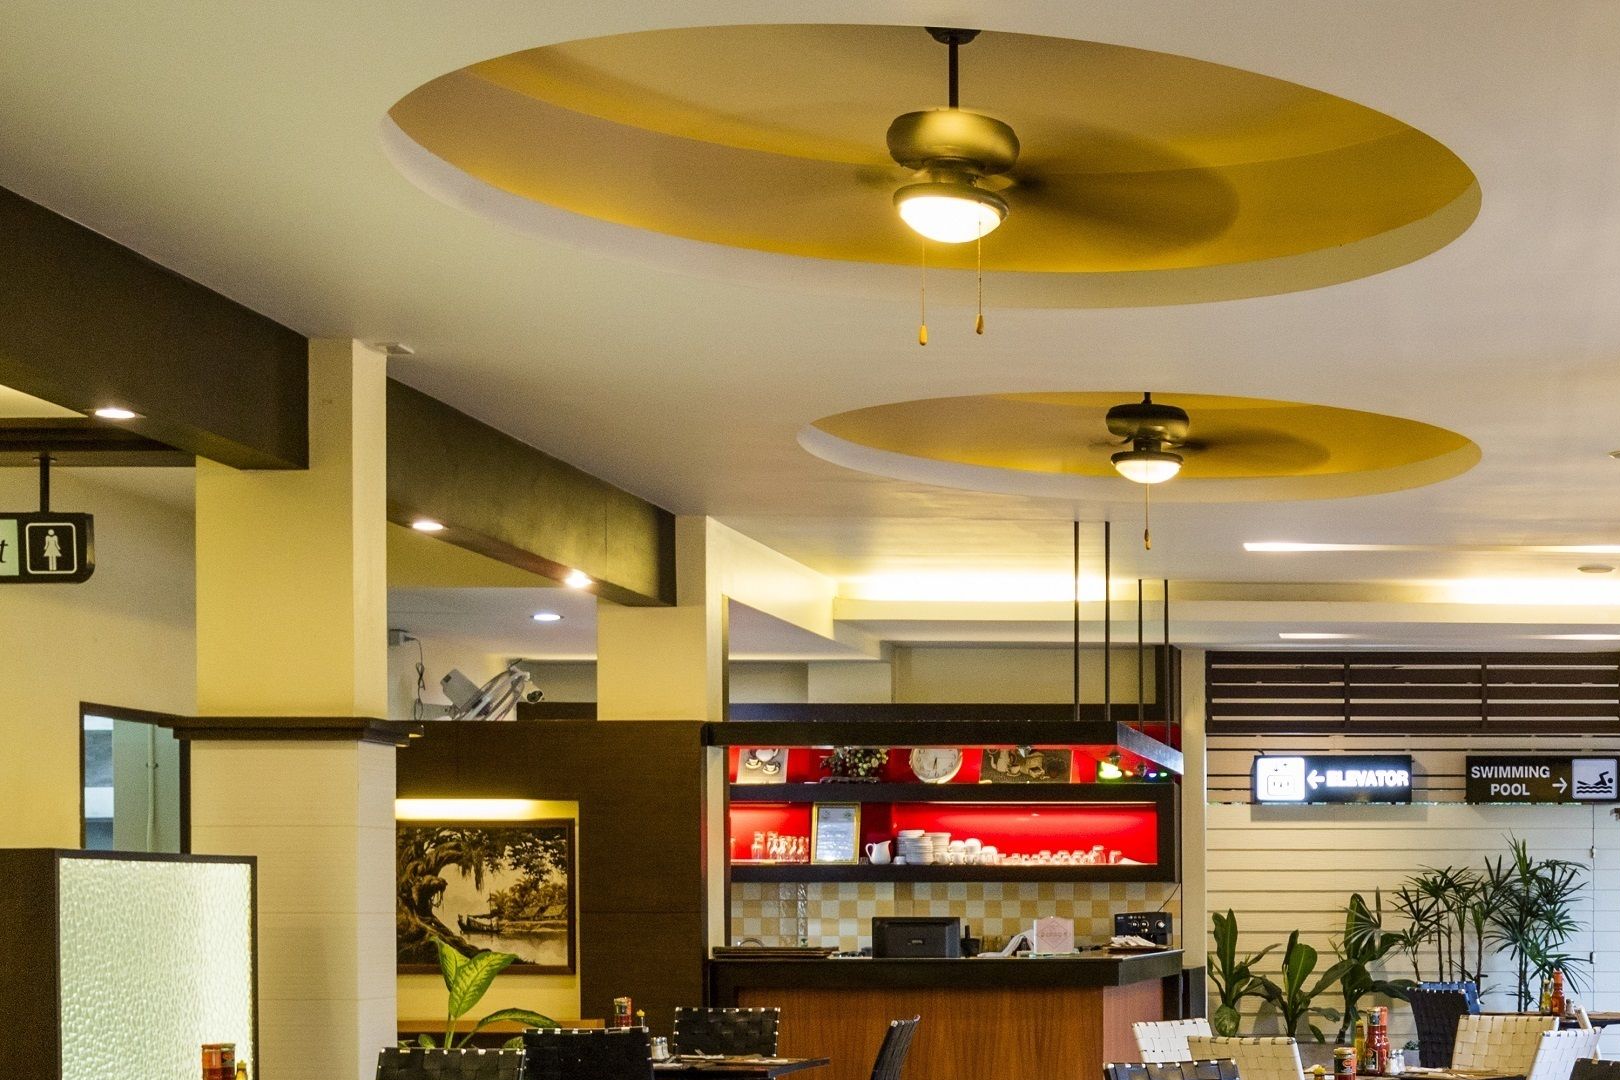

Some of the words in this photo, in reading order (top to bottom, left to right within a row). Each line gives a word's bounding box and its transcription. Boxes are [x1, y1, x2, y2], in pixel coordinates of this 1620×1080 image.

[1326, 769, 1410, 788] ELEVATOR
[1471, 765, 1551, 779] SWIMMING
[1490, 783, 1531, 796] POOL
